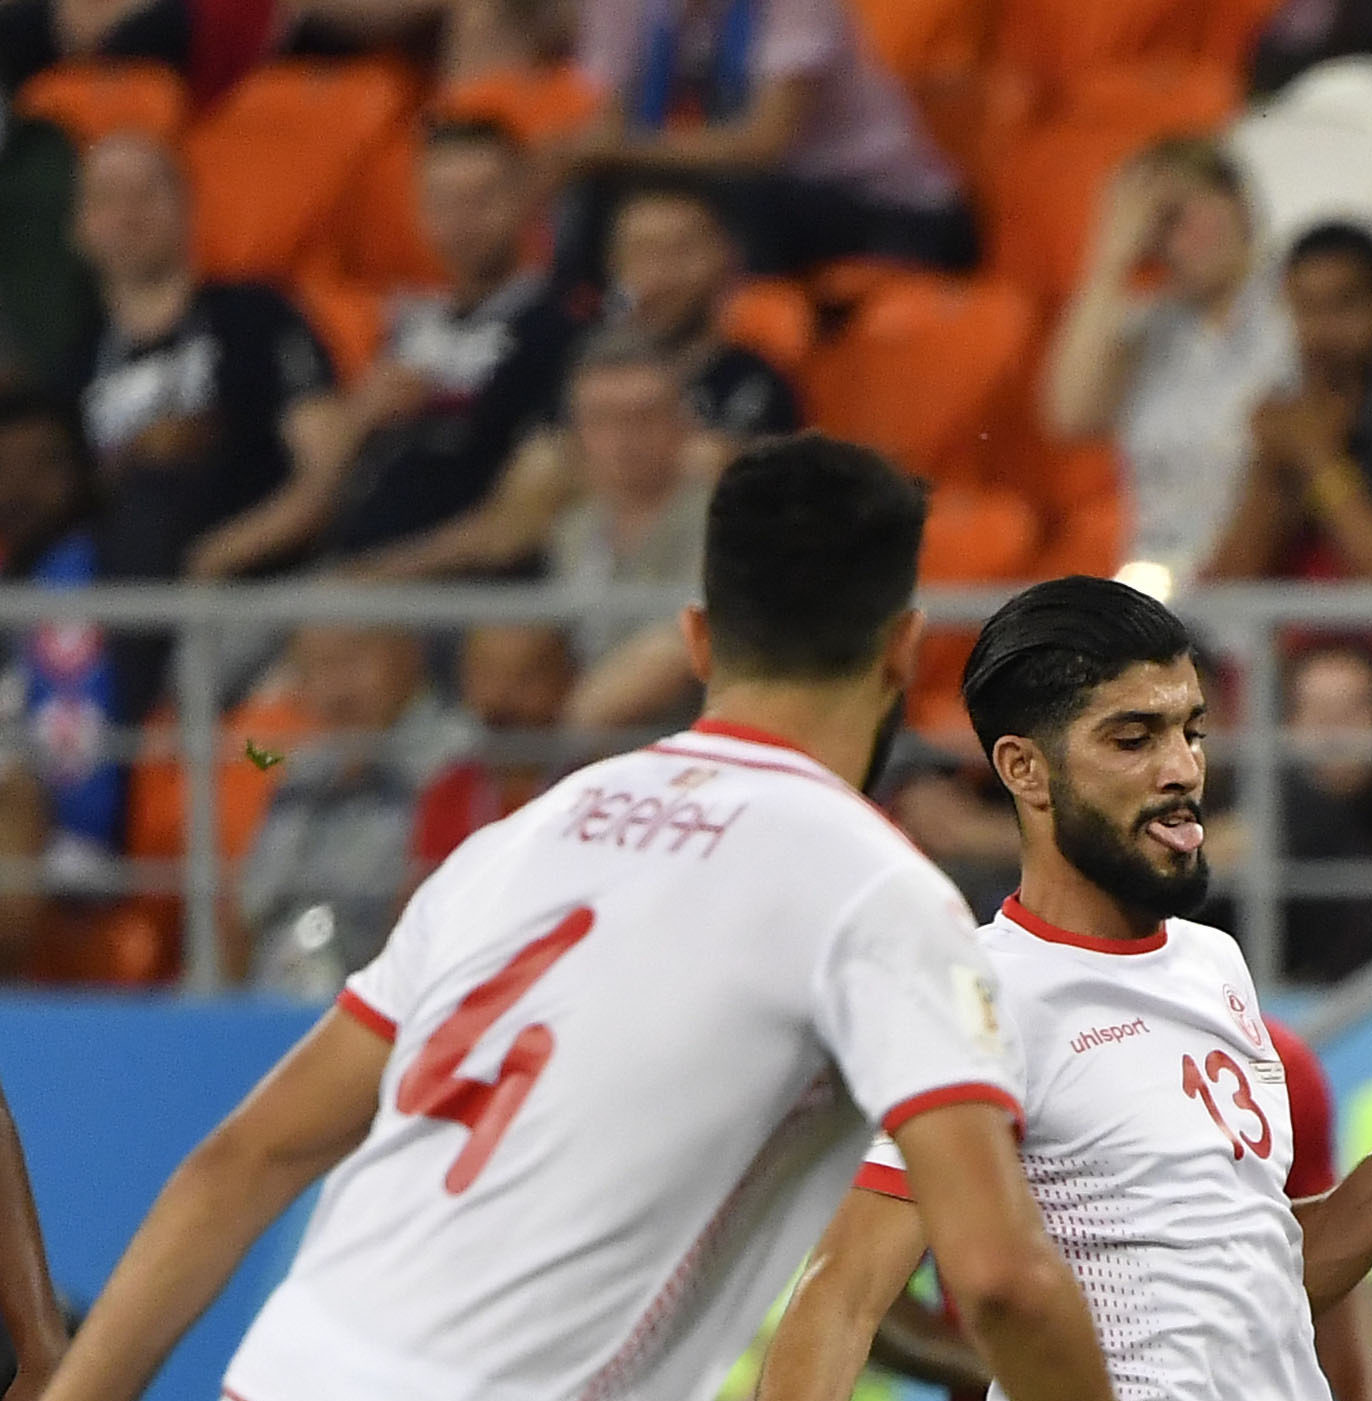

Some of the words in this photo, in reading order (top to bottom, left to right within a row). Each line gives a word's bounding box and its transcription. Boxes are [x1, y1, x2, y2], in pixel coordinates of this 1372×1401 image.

[396, 905, 596, 1197] 4
[1070, 1017, 1151, 1054] uhlsport
[1182, 1049, 1273, 1161] 13
